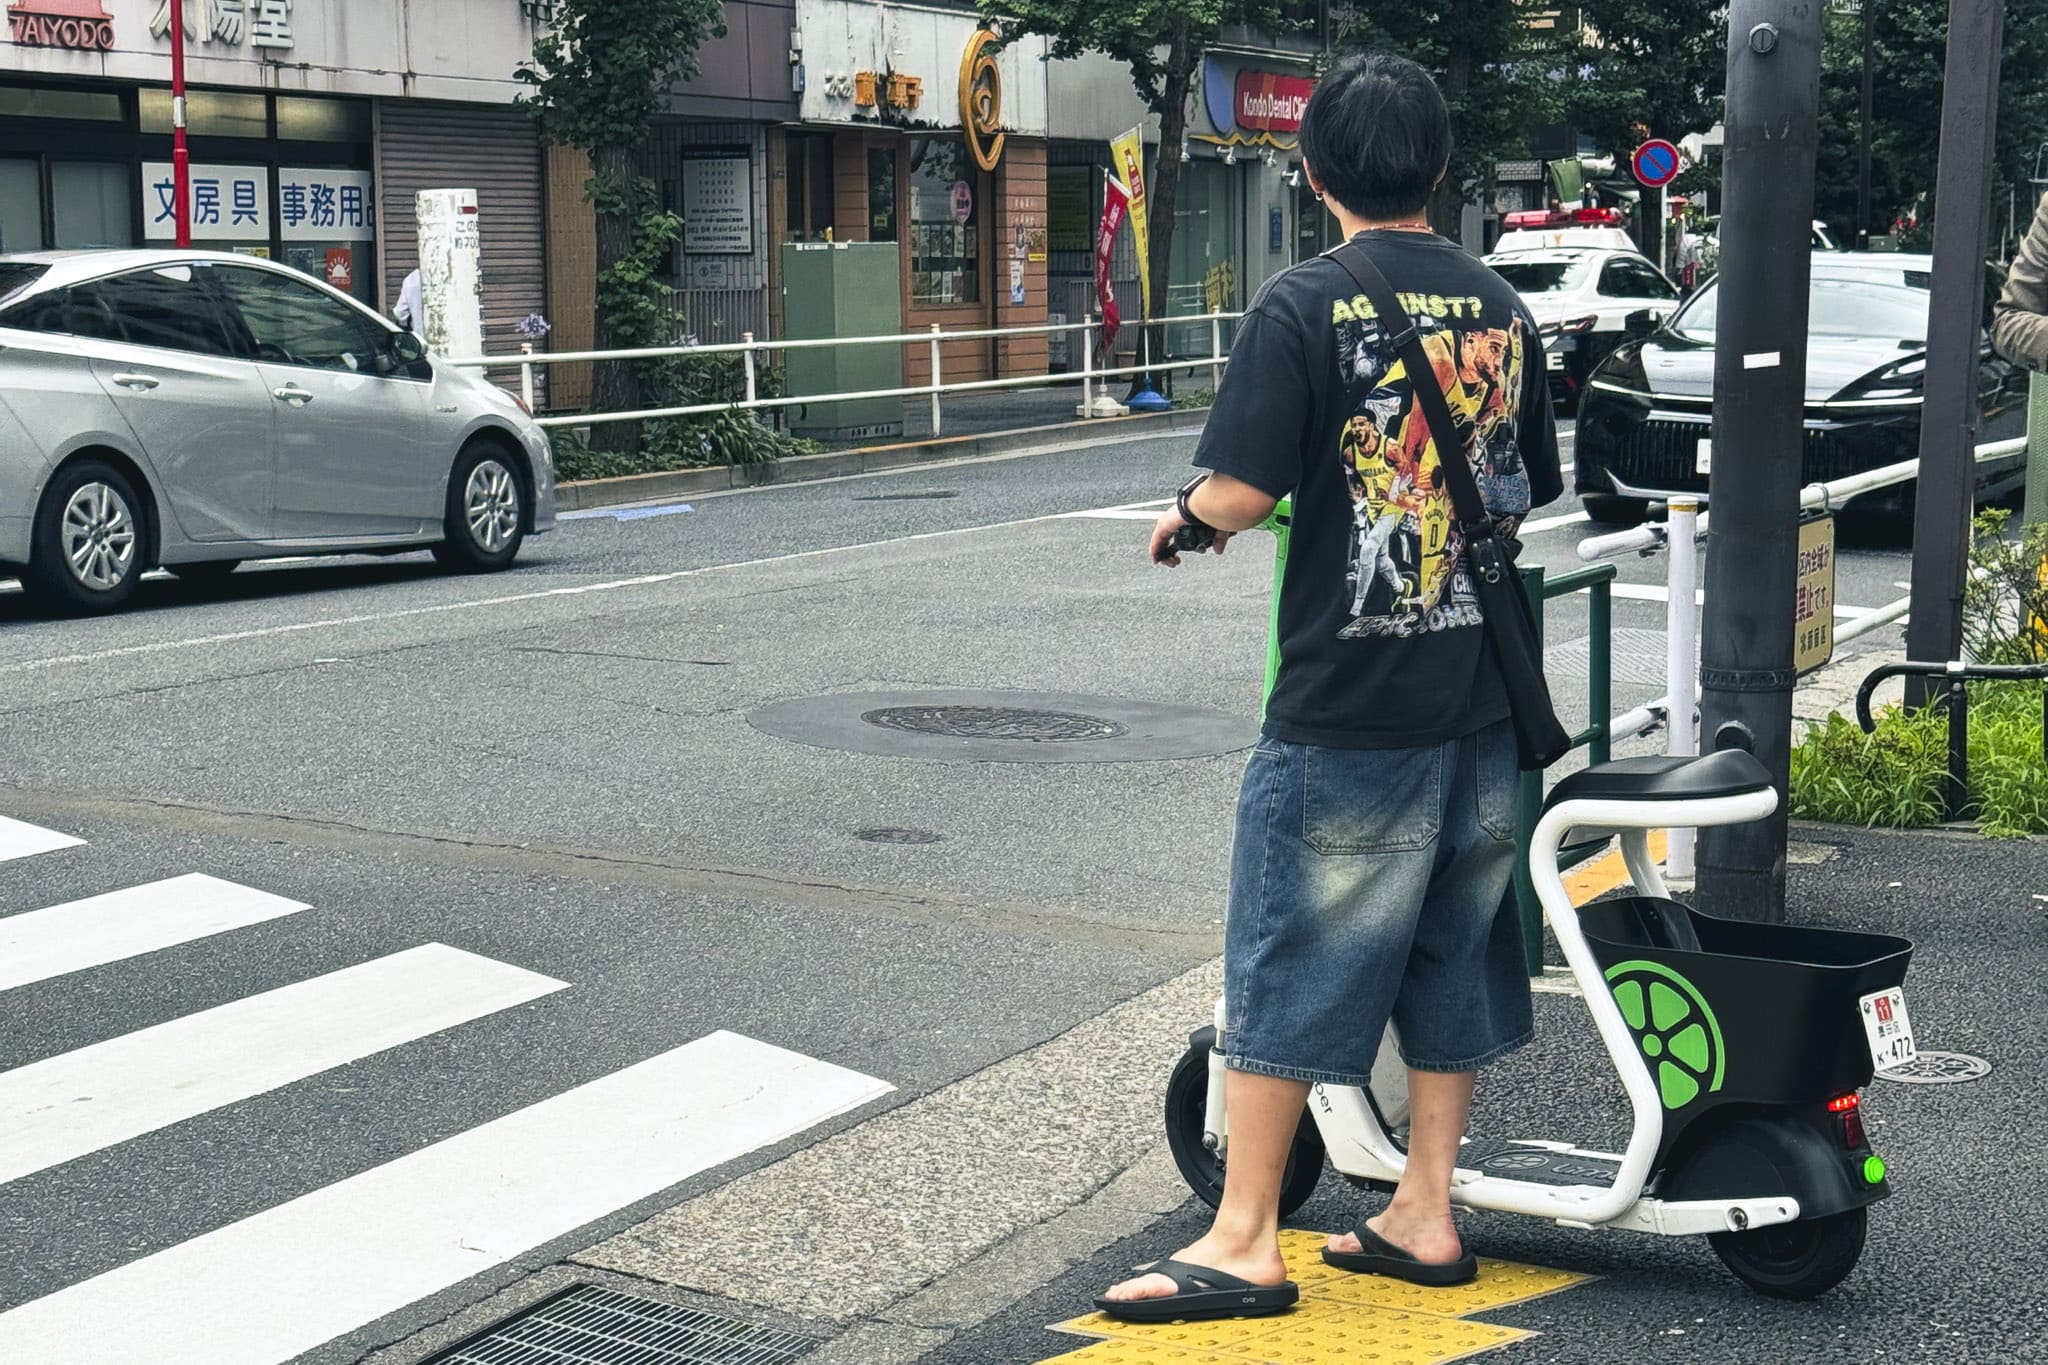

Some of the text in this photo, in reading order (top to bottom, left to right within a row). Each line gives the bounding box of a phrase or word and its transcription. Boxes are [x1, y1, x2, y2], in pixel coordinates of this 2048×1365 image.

[8, 16, 114, 49] TAIYODO
[1243, 91, 1268, 117] Kondo
[1268, 93, 1292, 120] Dental
[153, 177, 259, 226] 文房具
[1331, 293, 1483, 325] AGINST?
